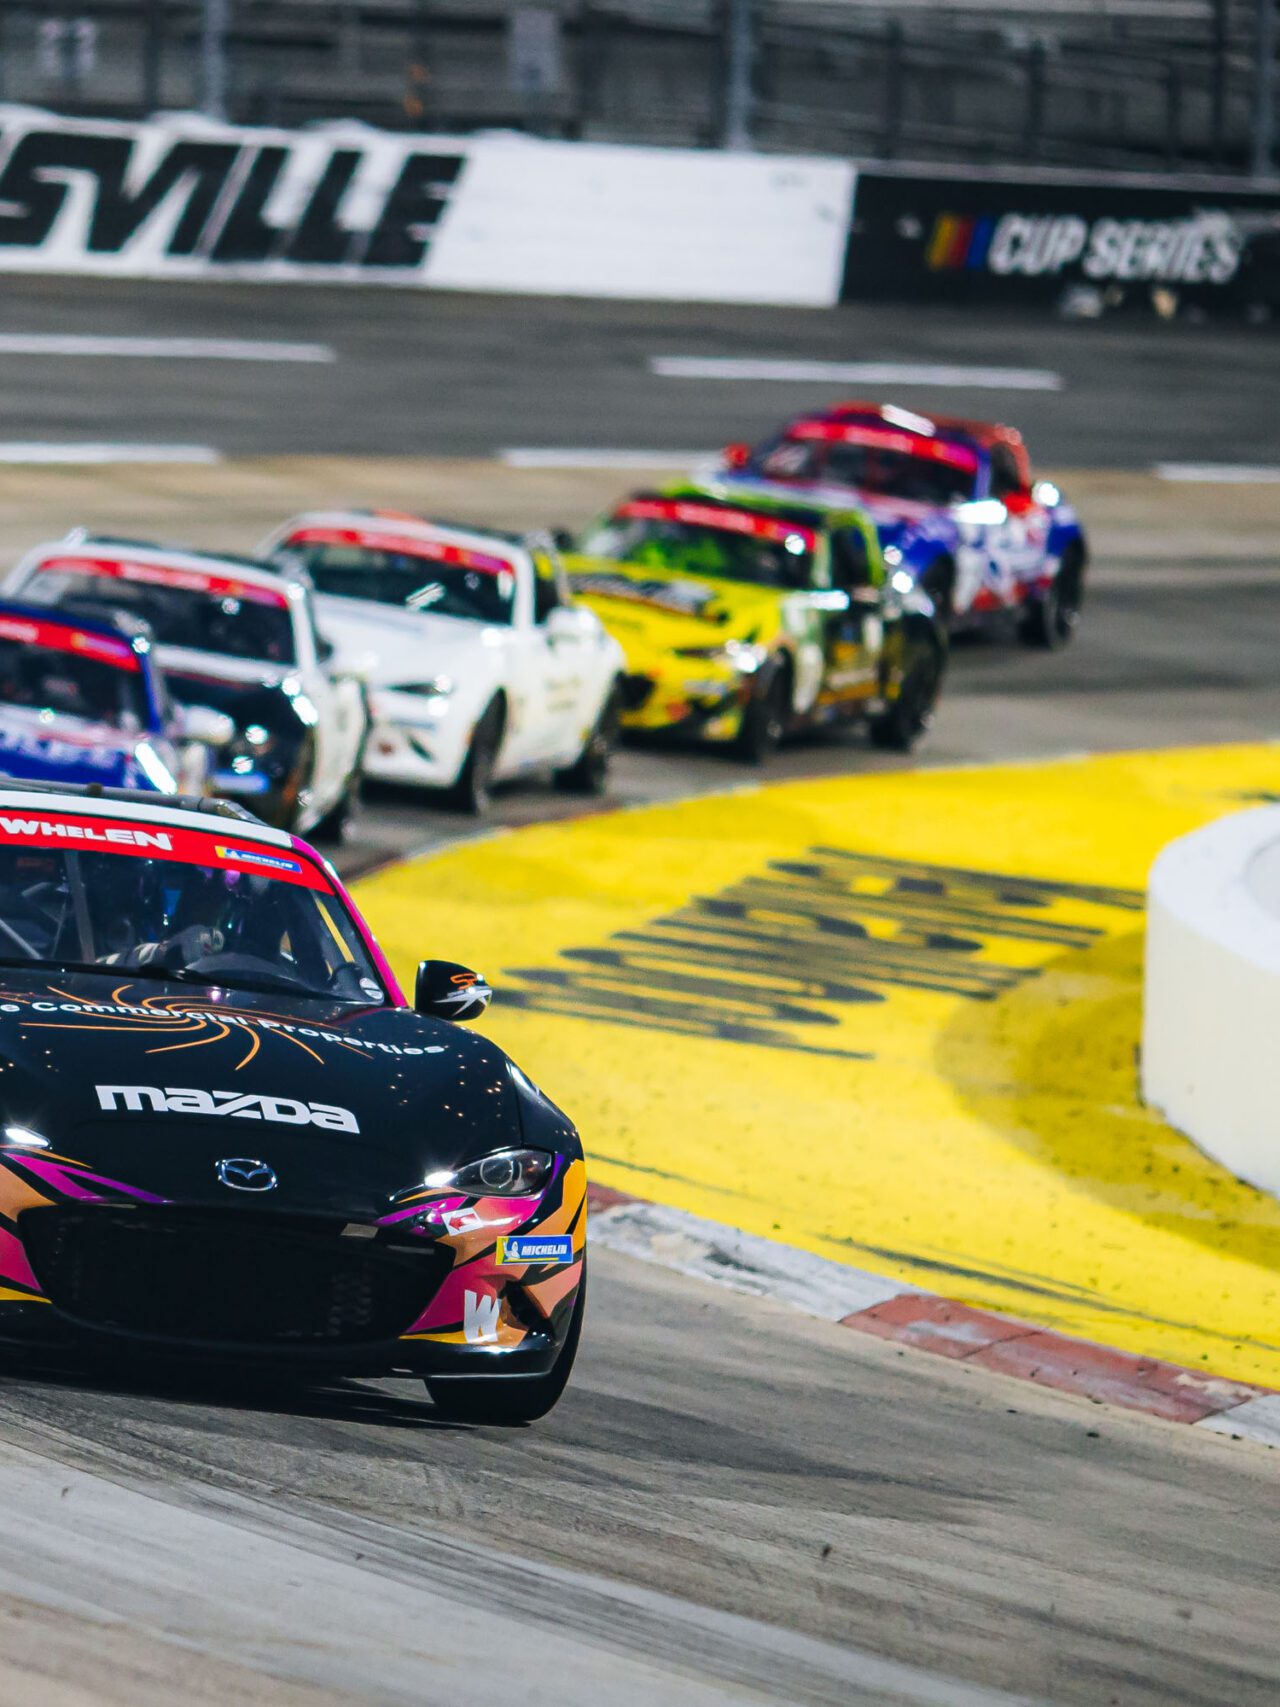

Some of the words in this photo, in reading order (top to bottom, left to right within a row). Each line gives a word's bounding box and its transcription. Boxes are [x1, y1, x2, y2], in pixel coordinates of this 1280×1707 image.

[988, 212, 1087, 276] CUP
[1082, 213, 1241, 284] SERIES
[31, 1001, 249, 1026] Commercial
[257, 1018, 446, 1055] Properties
[95, 1085, 361, 1134] mazda
[521, 1243, 568, 1256] MICHELIN
[463, 1289, 501, 1344] W
